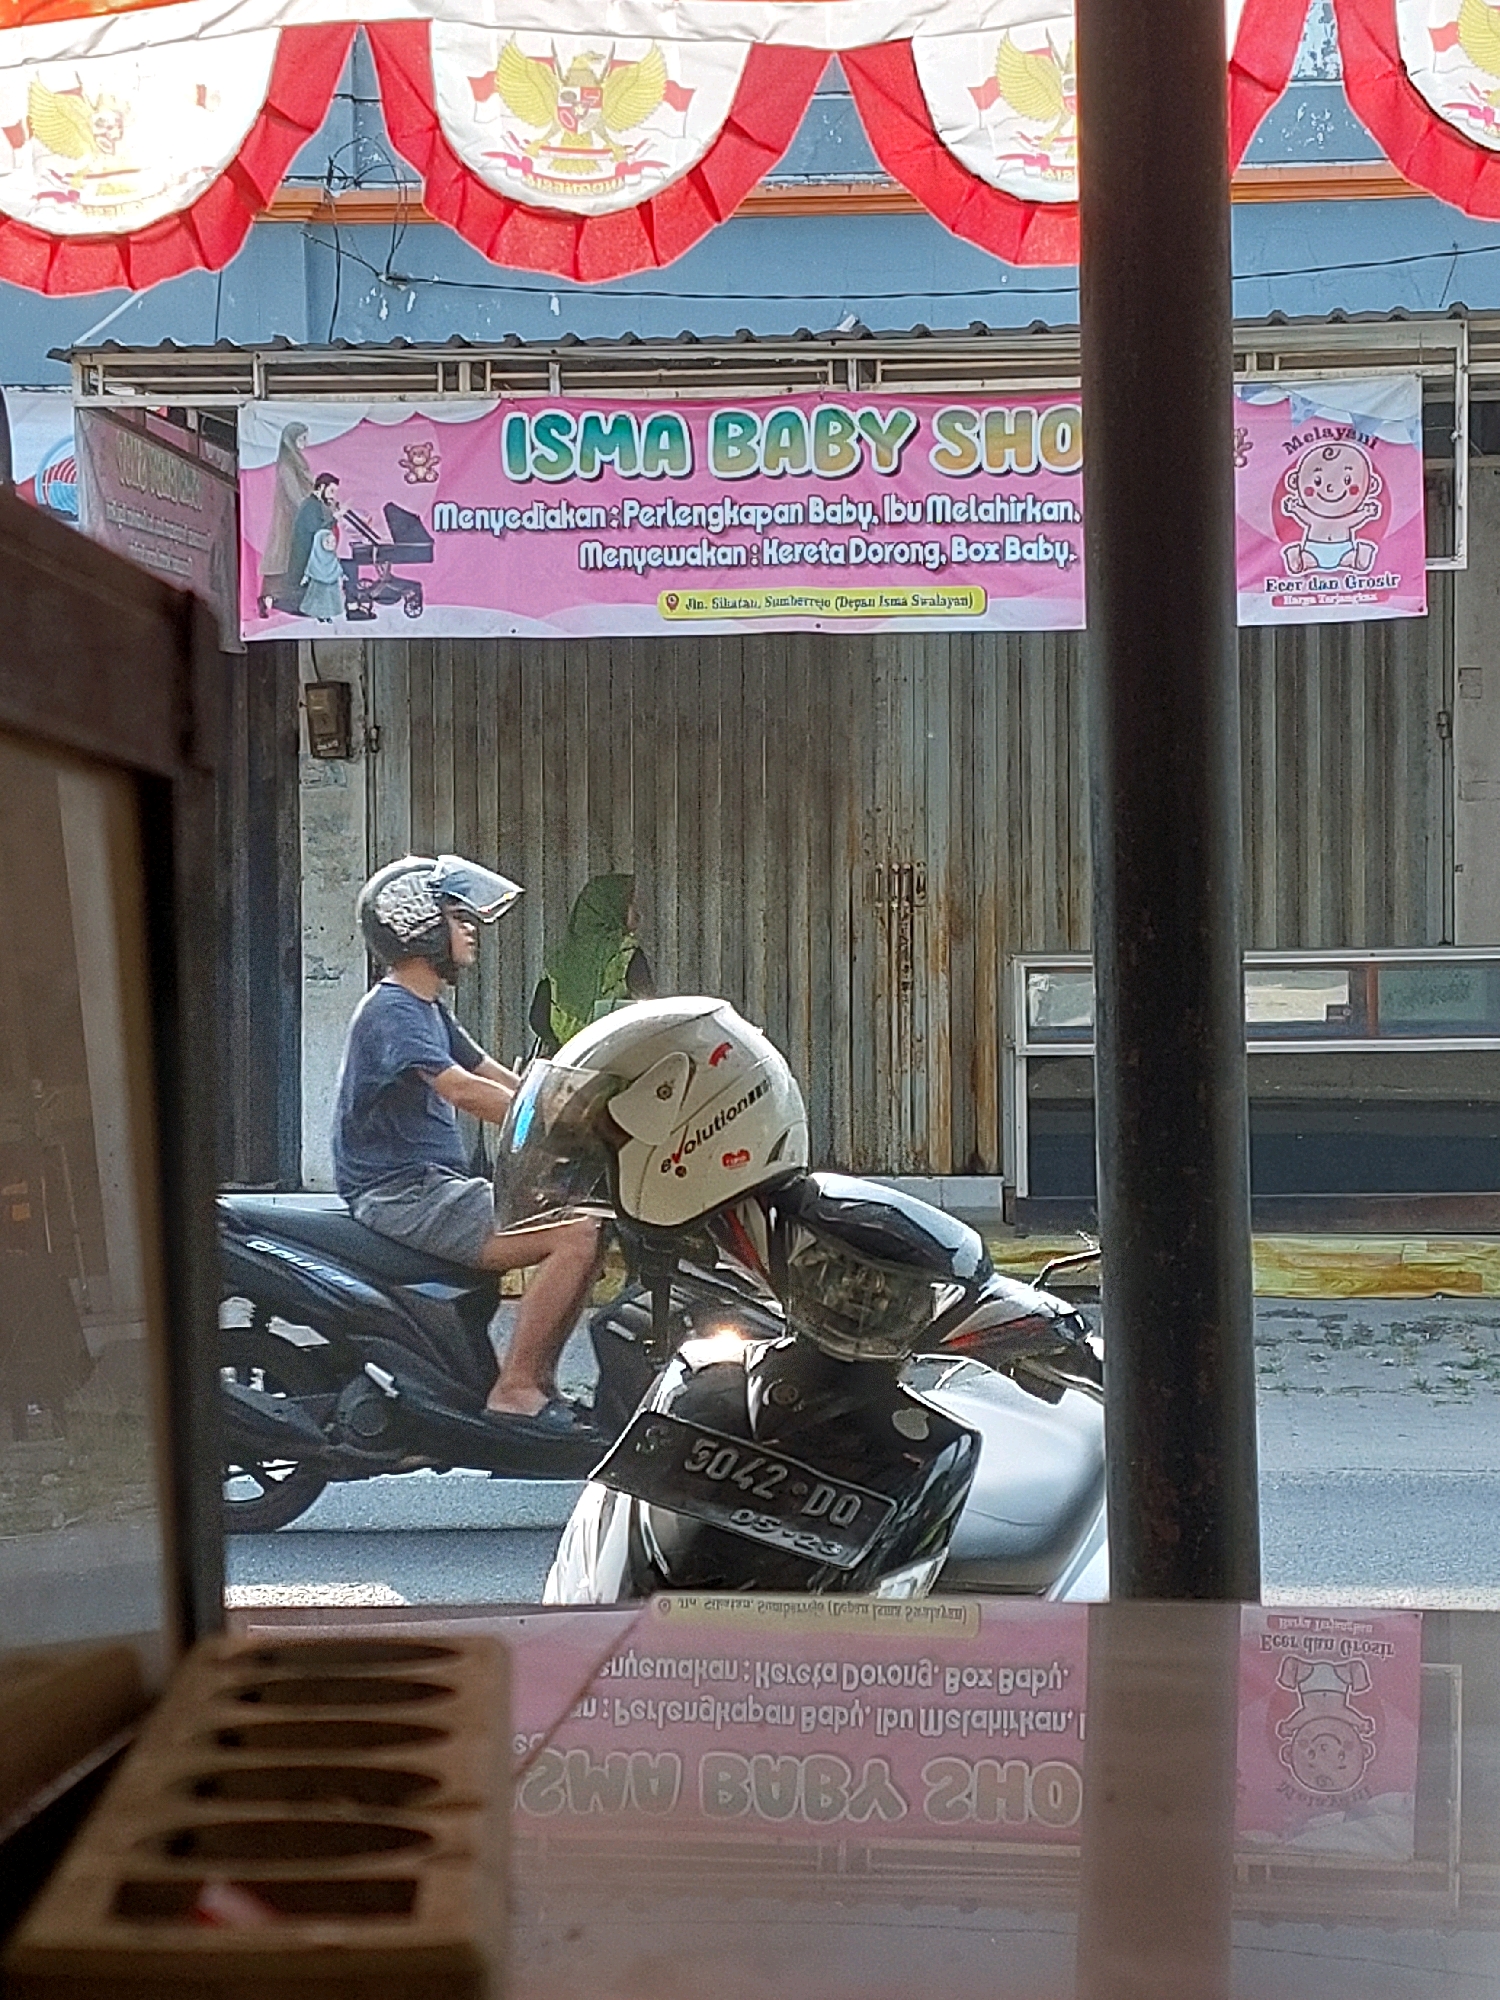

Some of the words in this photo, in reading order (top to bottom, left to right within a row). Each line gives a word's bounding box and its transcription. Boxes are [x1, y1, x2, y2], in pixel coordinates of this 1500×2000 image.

[502, 408, 693, 482] ISMA
[708, 404, 917, 478] BABY
[1281, 426, 1379, 456] Melayani
[622, 496, 803, 534] Perlengkapan
[808, 494, 880, 531] Baby,
[883, 492, 922, 524] Ibu
[926, 493, 1082, 525] Melahirkan,
[762, 536, 845, 569] Kereta
[849, 536, 947, 571] Dorong,
[951, 535, 999, 562] Box
[1265, 577, 1304, 593] Ecer
[1308, 575, 1339, 591] dan
[1345, 571, 1399, 589] Grosir
[879, 594, 908, 607] Isma
[911, 592, 973, 609] Swalayan)
[684, 1438, 788, 1500] 5042
